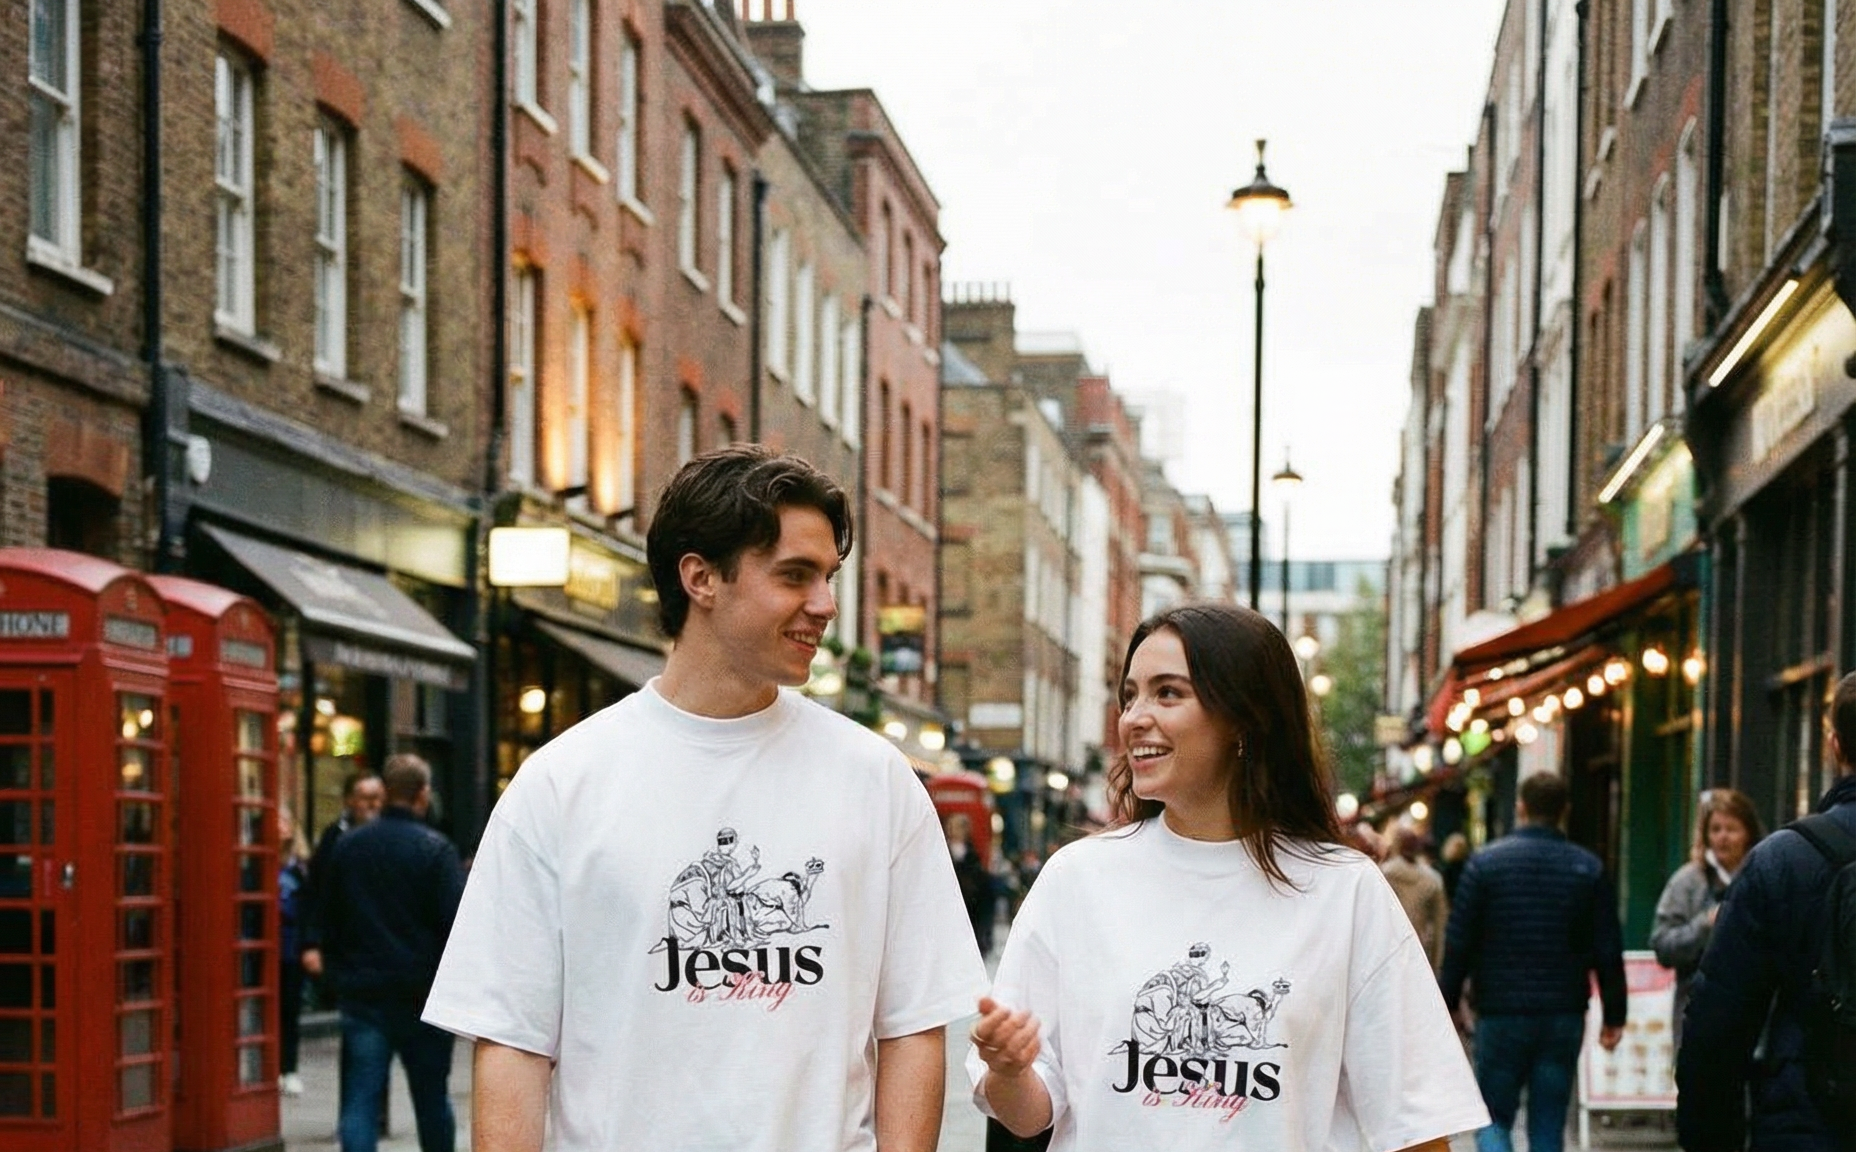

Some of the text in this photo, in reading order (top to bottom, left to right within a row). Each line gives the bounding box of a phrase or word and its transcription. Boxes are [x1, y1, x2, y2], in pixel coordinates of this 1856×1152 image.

[655, 937, 824, 992] Jesus
[687, 971, 793, 1011] is King
[1112, 1039, 1281, 1101] Jesus
[1142, 1081, 1249, 1123] is King
